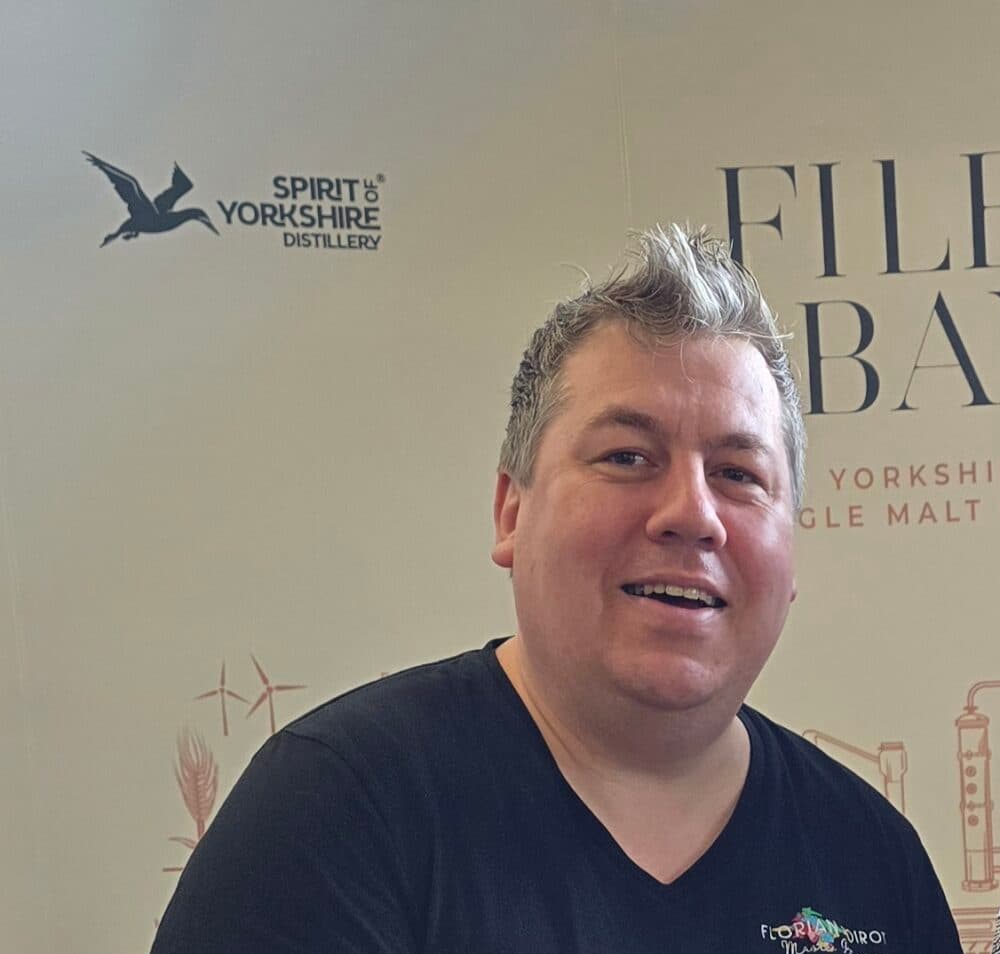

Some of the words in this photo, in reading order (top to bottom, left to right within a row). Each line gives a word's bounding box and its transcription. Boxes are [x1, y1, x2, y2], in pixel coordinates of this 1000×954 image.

[272, 175, 359, 202] SPIRIT
[363, 178, 379, 203] OF
[216, 200, 382, 230] YORKSHIRE
[283, 231, 382, 250] DISTILLERY
[886, 499, 982, 525] MALT
[761, 918, 839, 941] FLORIAN
